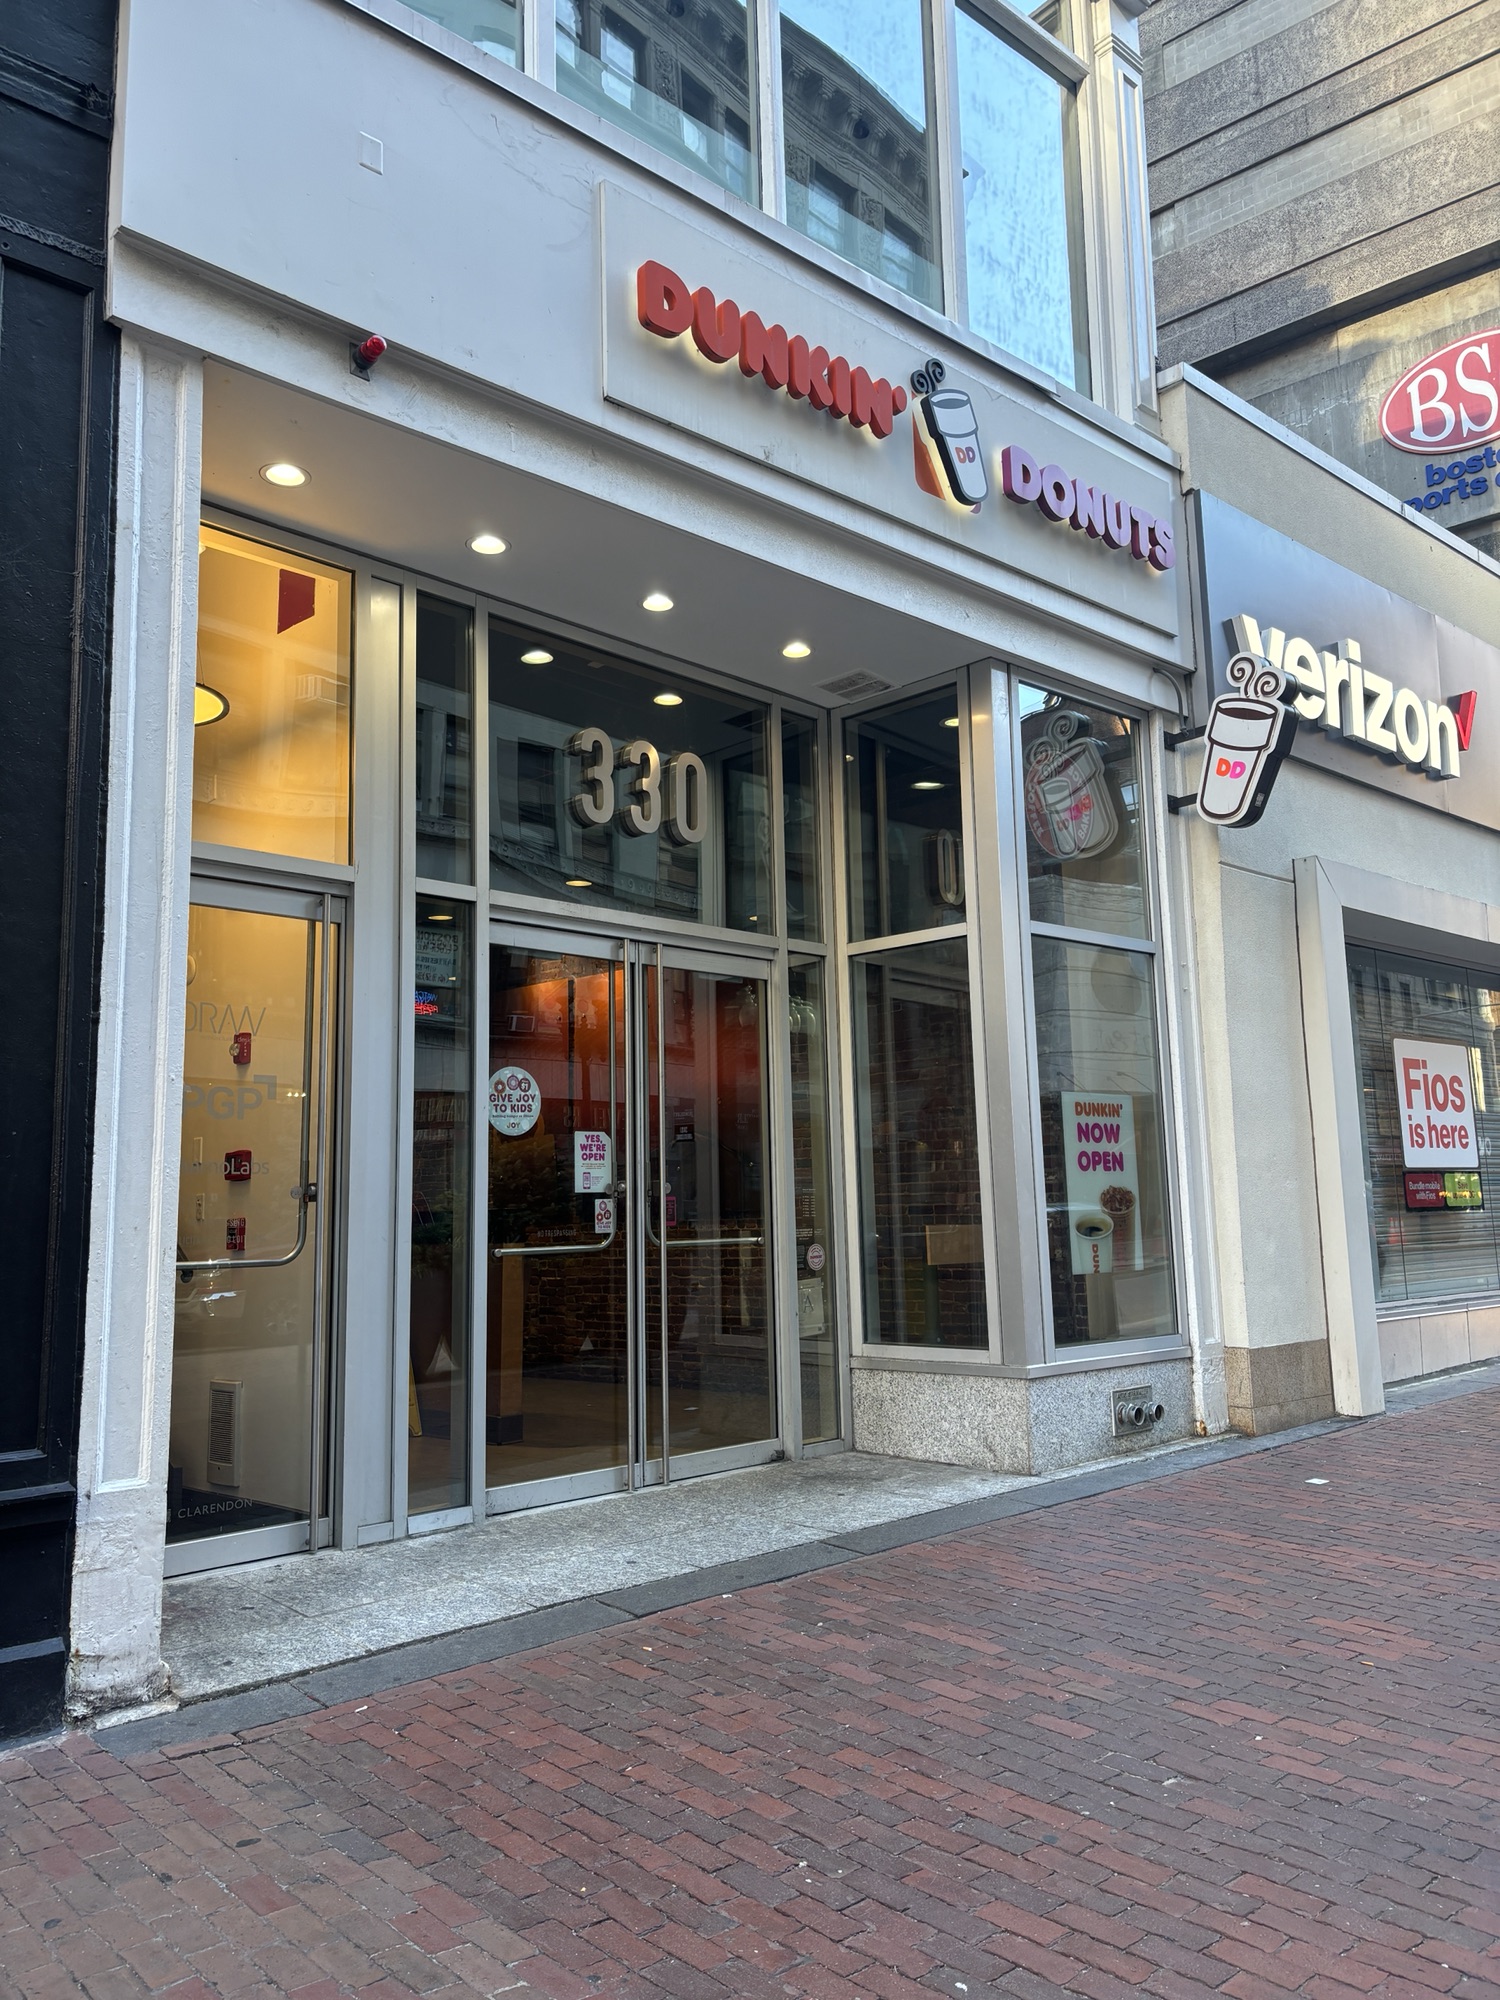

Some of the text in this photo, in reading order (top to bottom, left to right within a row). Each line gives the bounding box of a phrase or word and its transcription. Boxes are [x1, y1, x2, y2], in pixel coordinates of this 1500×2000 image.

[637, 260, 1176, 571] DUNKIN' DONUTS
[955, 446, 975, 463] DD
[1223, 613, 1460, 779] verizon
[1216, 757, 1246, 779] DD
[568, 727, 707, 844] 330
[1402, 1057, 1466, 1113] Fios
[489, 1094, 536, 1102] GIVE JOY
[493, 1104, 533, 1113] TO KIDS
[1075, 1101, 1123, 1118] DUNKIN'
[585, 1134, 603, 1144] YES,
[1077, 1122, 1120, 1144] NOW
[1407, 1114, 1426, 1149] is
[1426, 1115, 1469, 1149] here
[580, 1143, 607, 1152] WE'RE
[581, 1153, 605, 1161] OPEN
[1077, 1150, 1124, 1172] OPEN
[178, 1499, 253, 1518] CLARENDON
